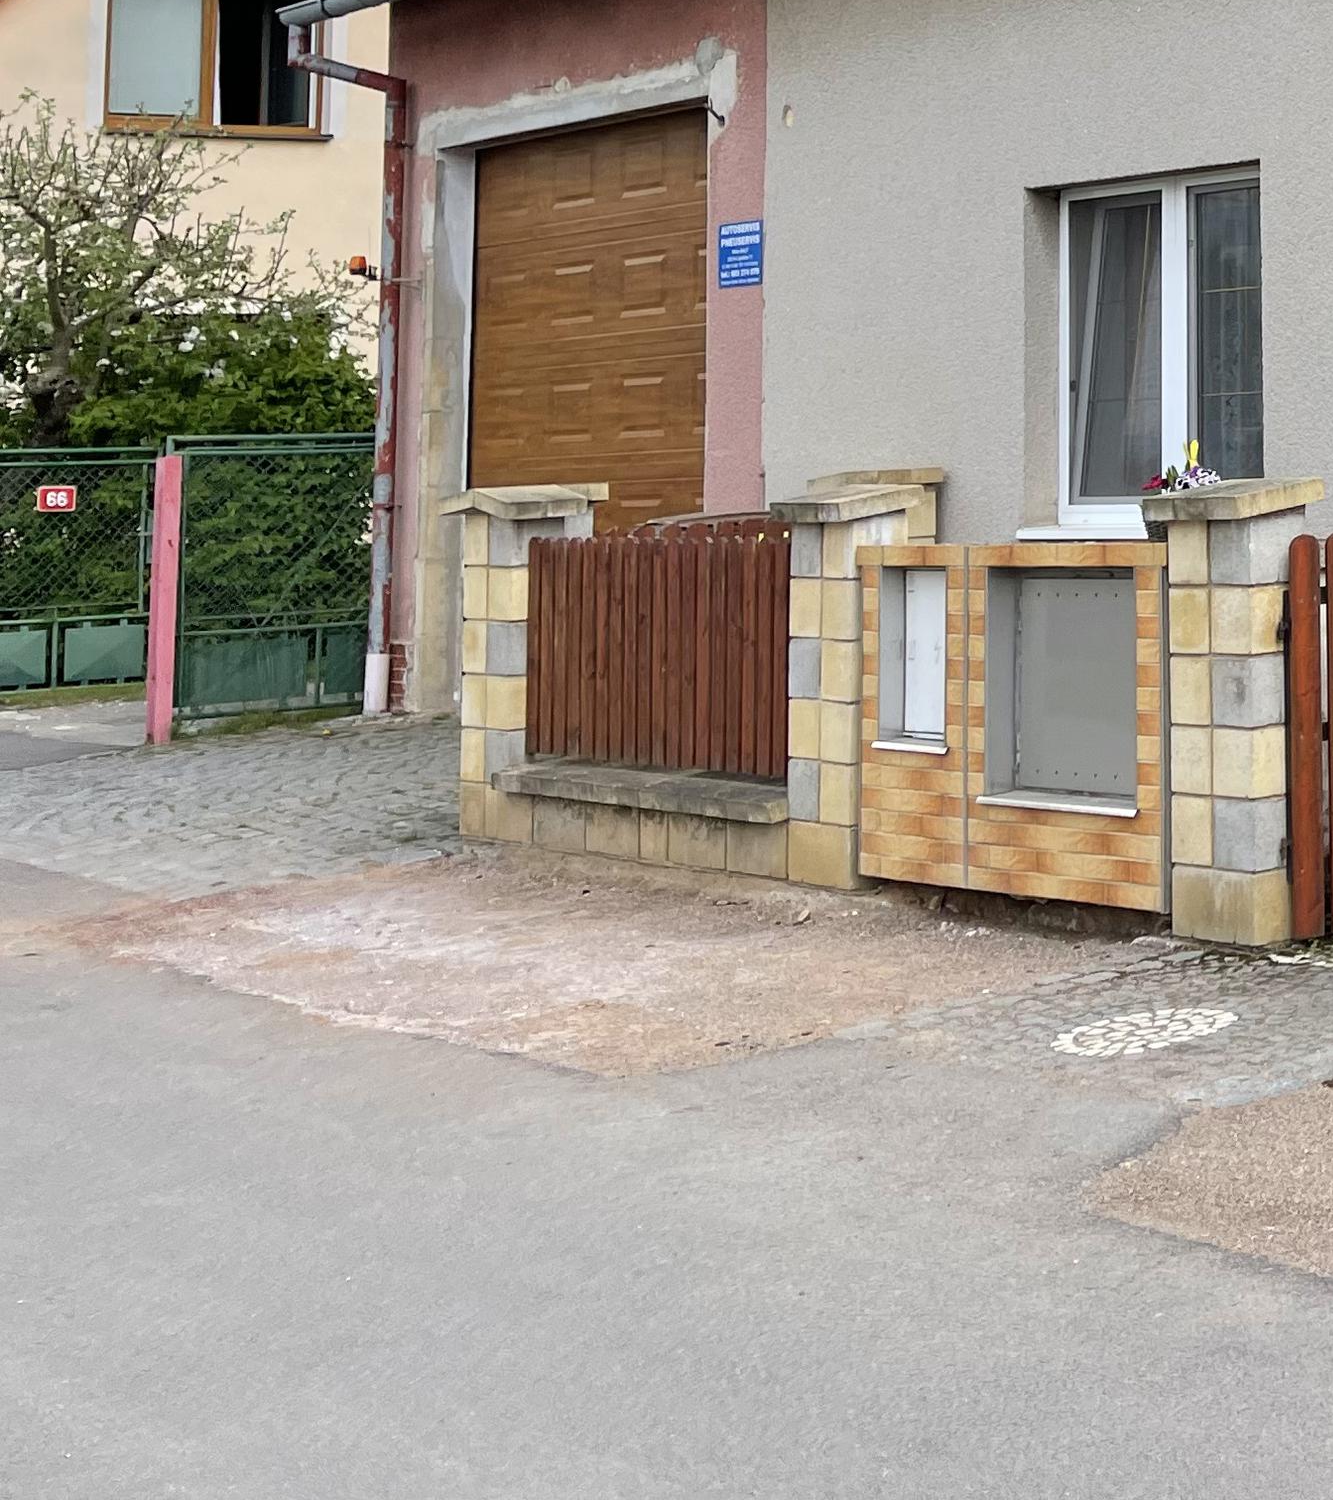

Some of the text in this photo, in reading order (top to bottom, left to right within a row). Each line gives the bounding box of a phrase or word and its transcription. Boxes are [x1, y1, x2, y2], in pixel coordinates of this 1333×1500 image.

[721, 222, 760, 235] AUTOSERVIS
[721, 234, 760, 248] PNEUSERVIS
[46, 491, 69, 507] 66
